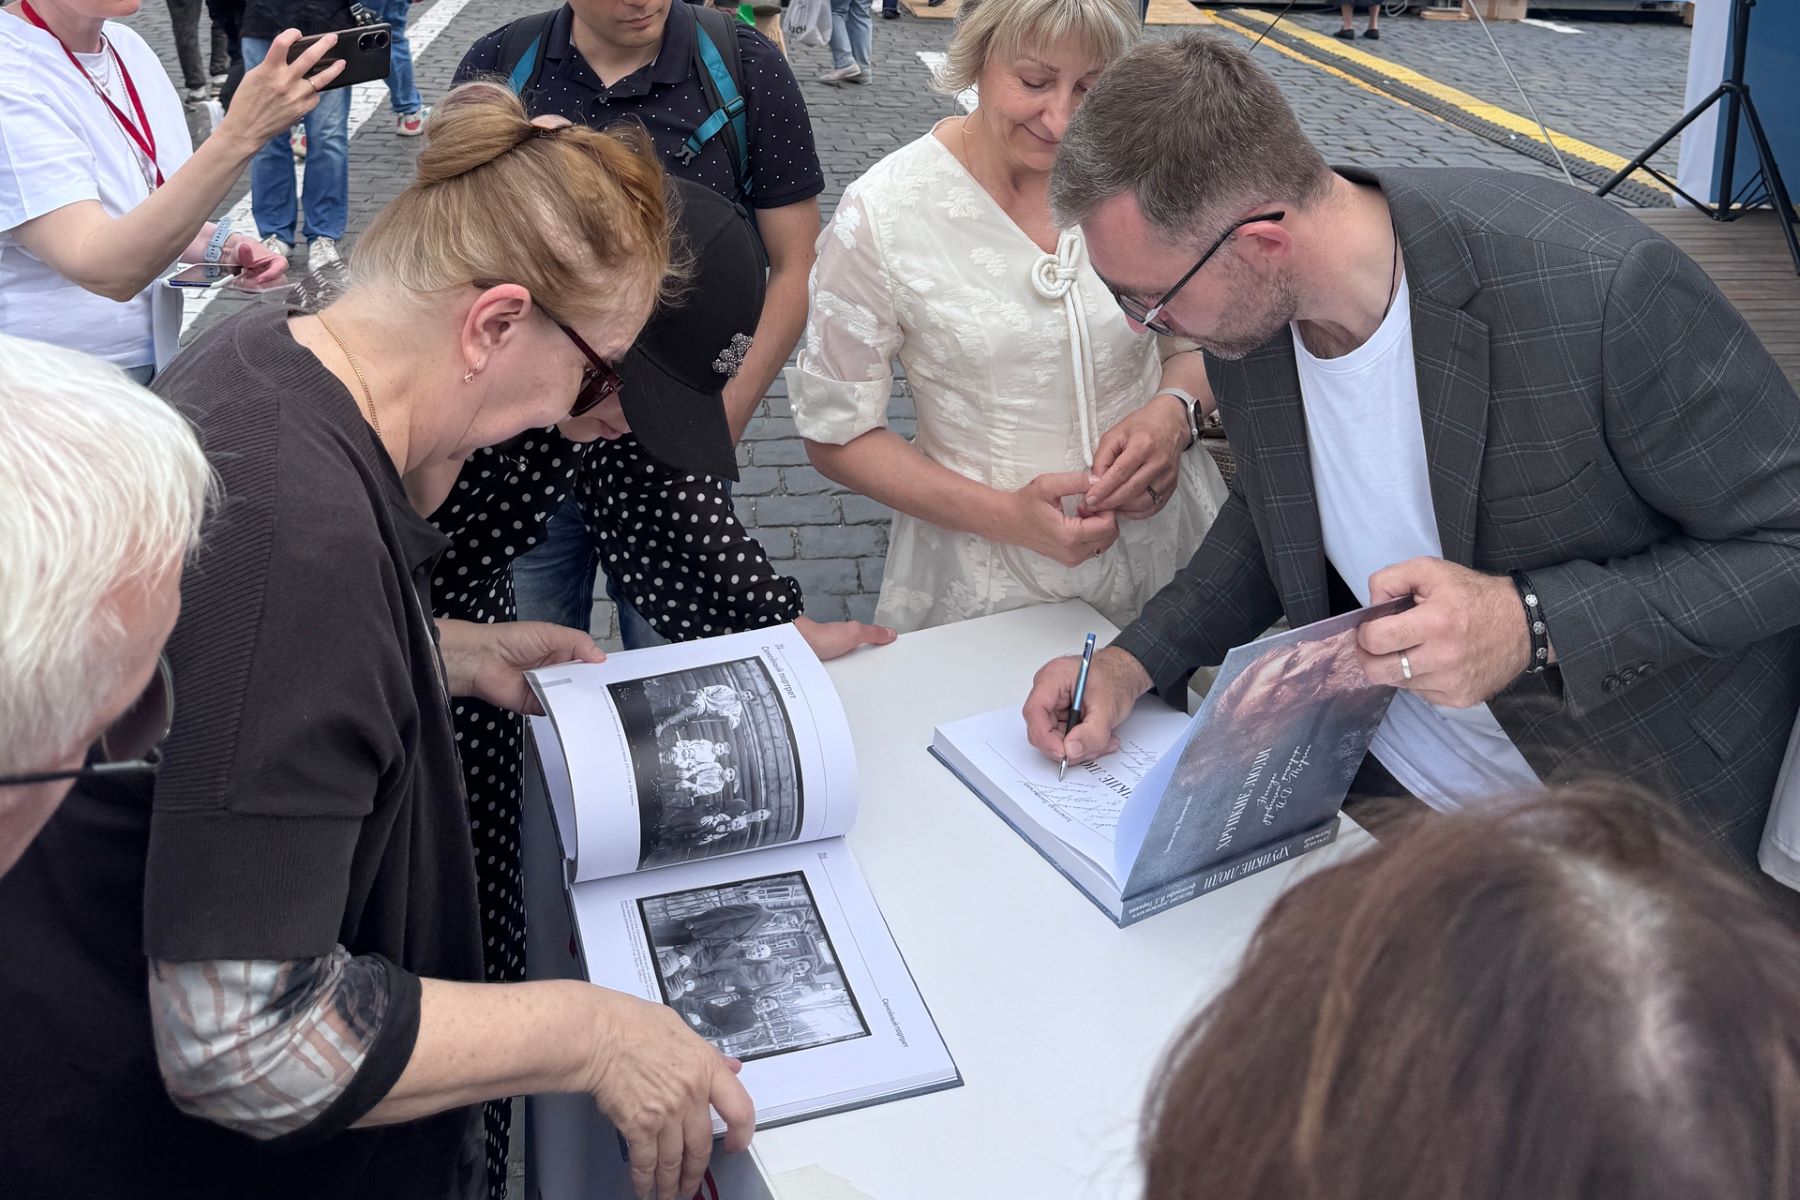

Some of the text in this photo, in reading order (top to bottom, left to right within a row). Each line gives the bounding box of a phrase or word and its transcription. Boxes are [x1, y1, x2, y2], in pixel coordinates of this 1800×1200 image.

[1215, 747, 1273, 852] ХРУПКИЕ ЛЮДИ
[1203, 844, 1292, 890] ХРУПКИЕ ЛЮДИ
